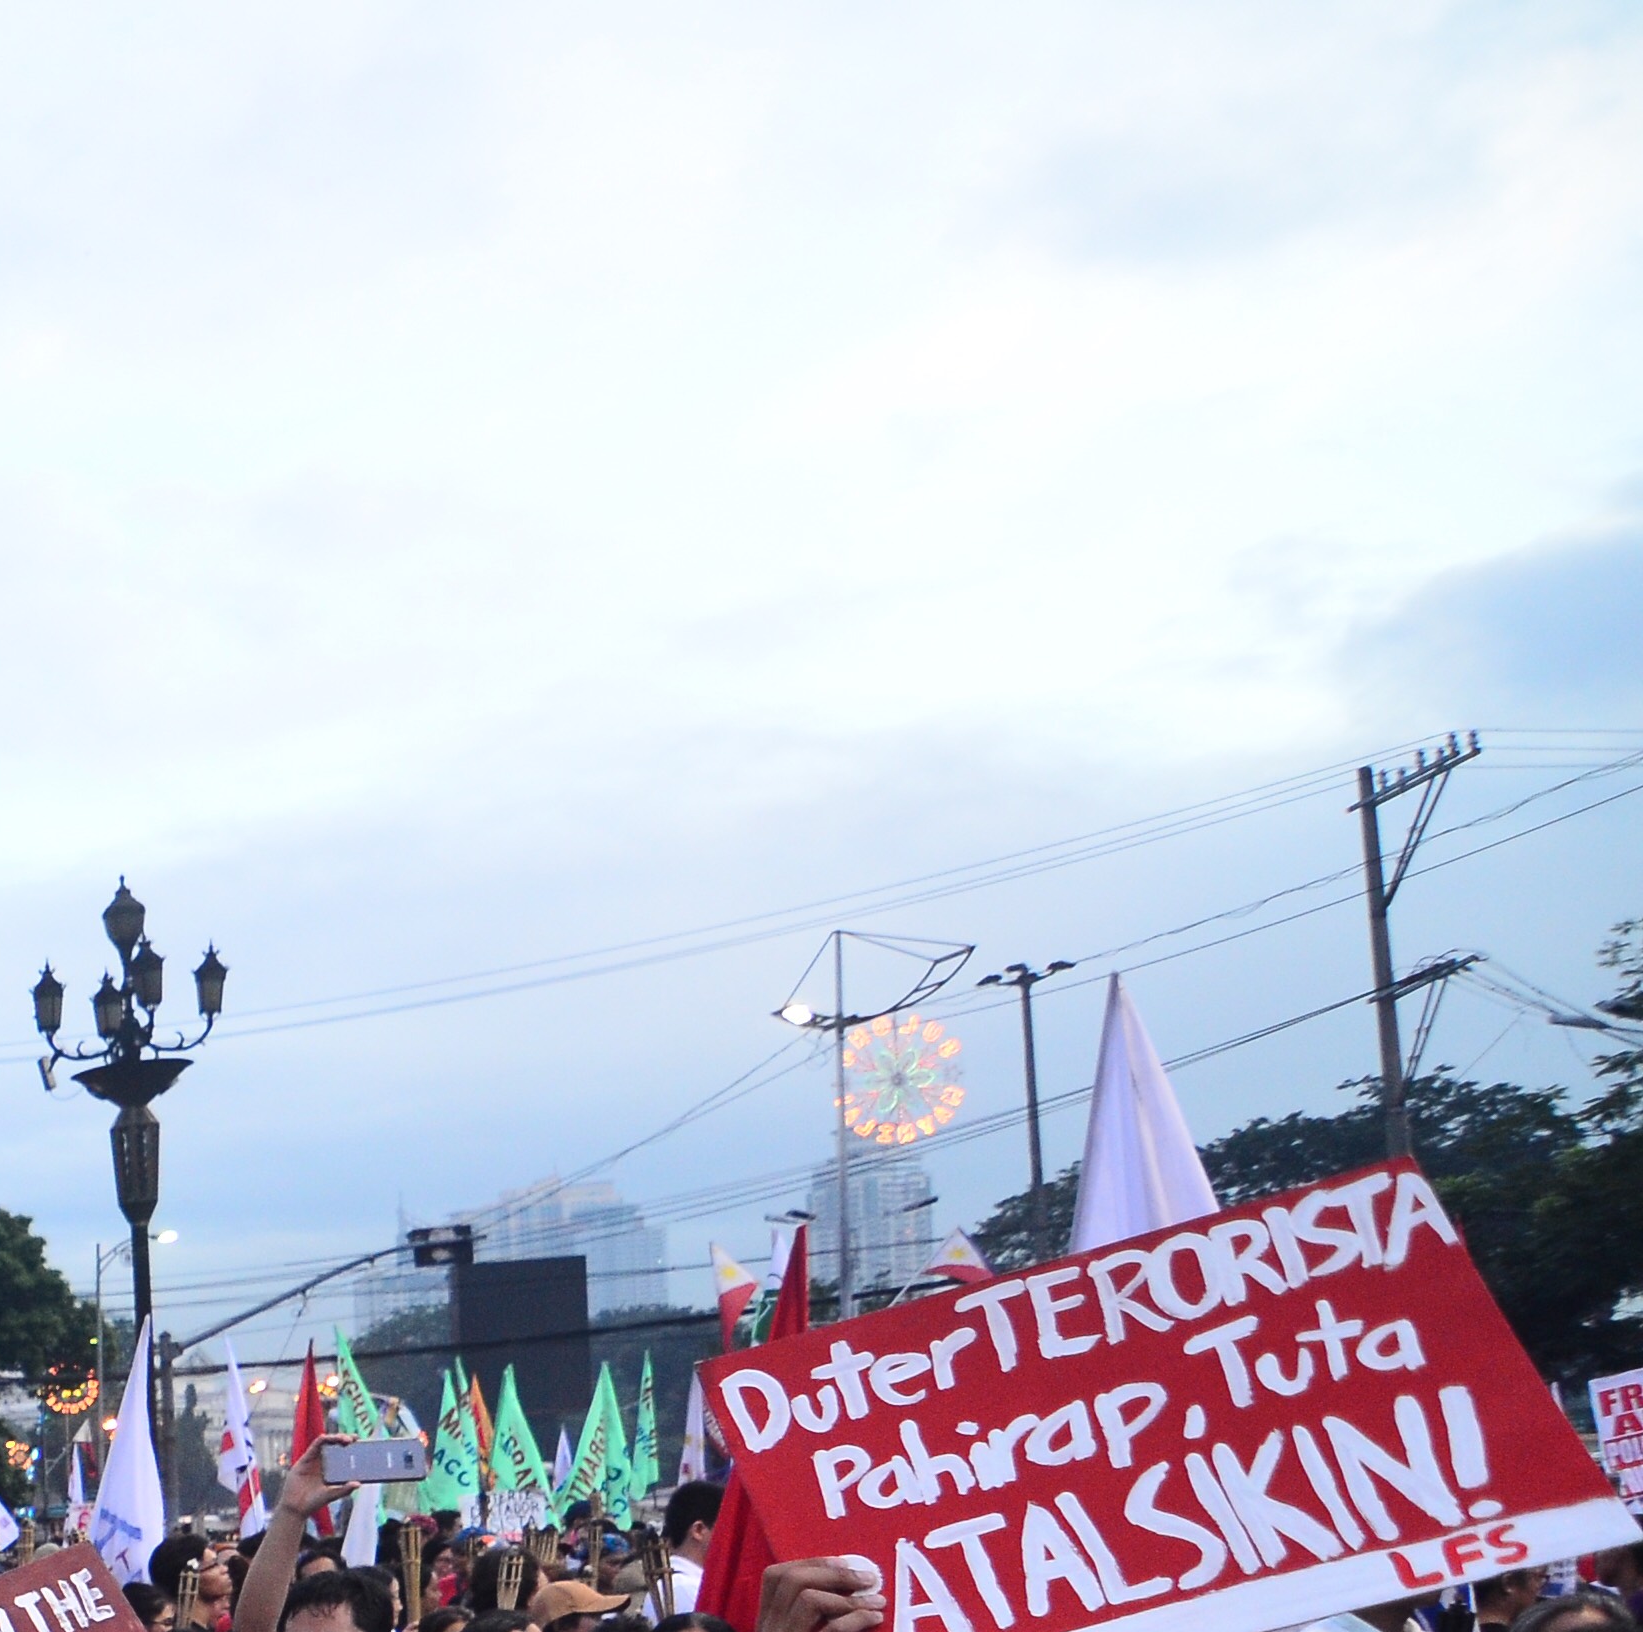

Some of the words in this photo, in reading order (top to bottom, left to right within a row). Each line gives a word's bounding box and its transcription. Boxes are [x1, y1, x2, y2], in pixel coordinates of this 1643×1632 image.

[719, 1171, 1460, 1454] DuterTERORISTA
[1183, 1299, 1425, 1409] Tuta
[1388, 1524, 1528, 1590] LFS
